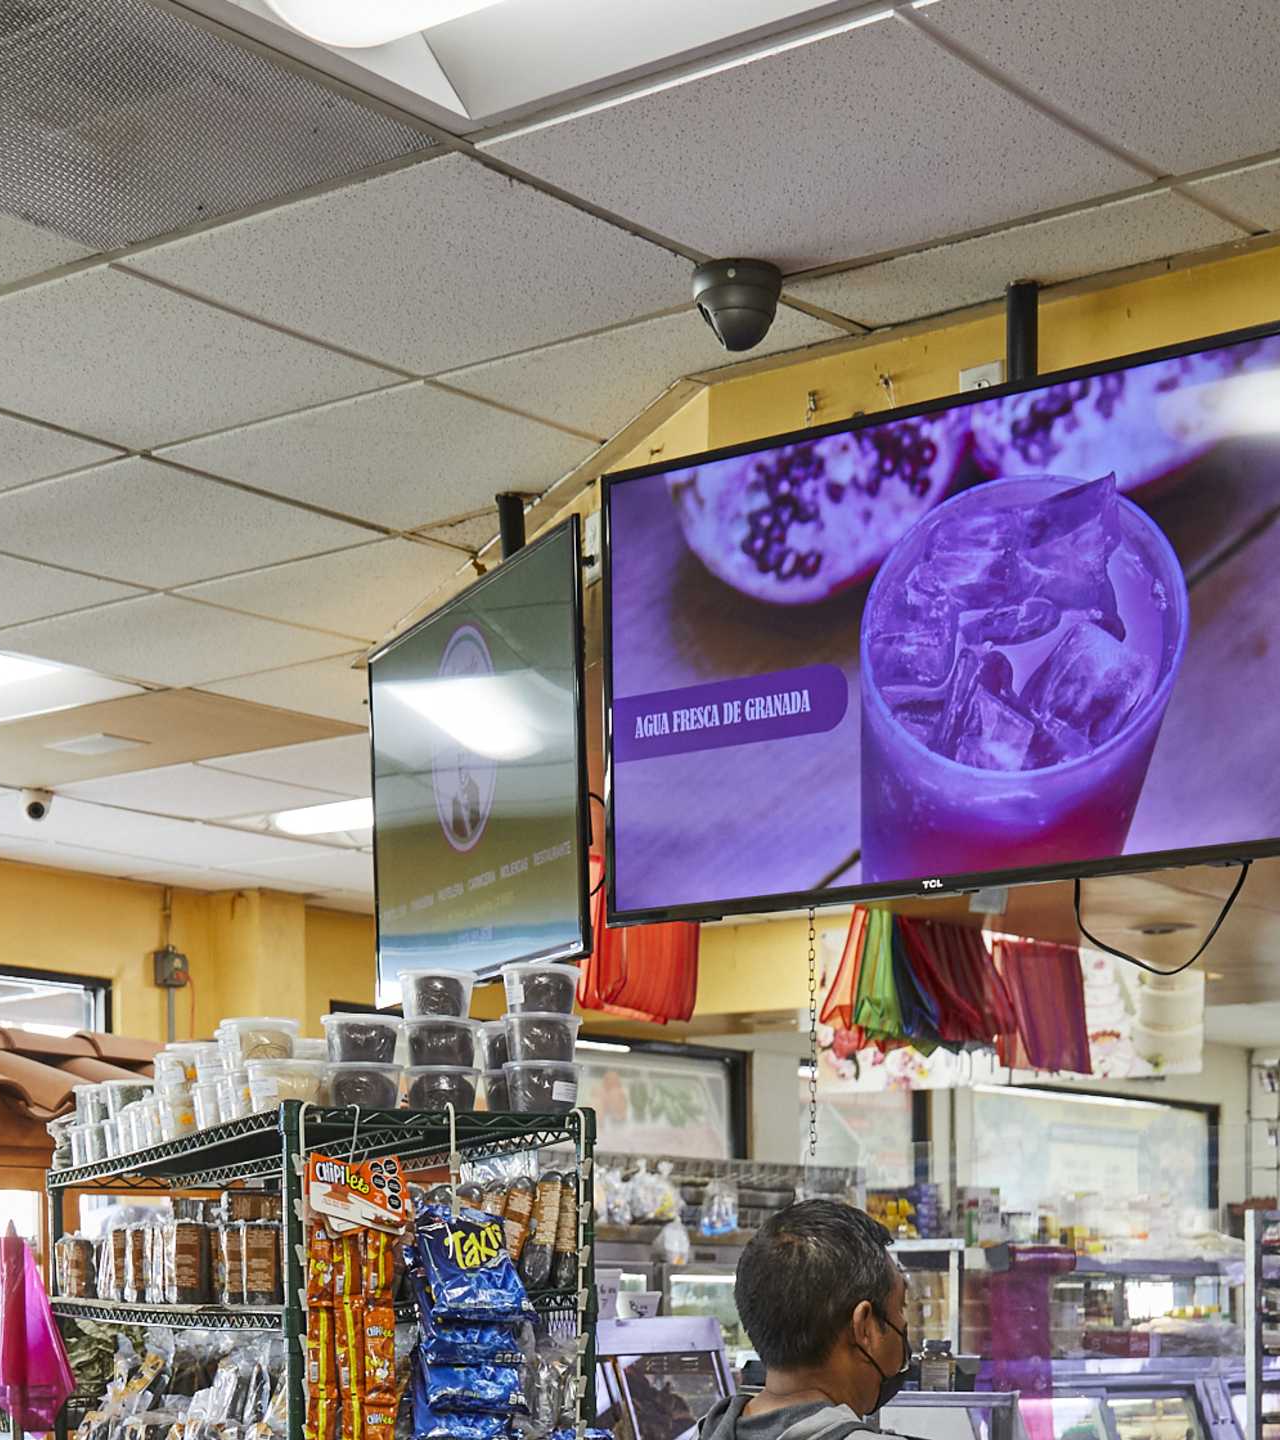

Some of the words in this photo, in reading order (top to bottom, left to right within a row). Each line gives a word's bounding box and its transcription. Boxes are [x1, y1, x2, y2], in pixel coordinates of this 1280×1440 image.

[635, 712, 670, 739] AGUA
[672, 704, 720, 733] FRESCA
[723, 700, 741, 725] DE
[744, 689, 811, 721] GRANADA
[922, 878, 943, 889] TCL
